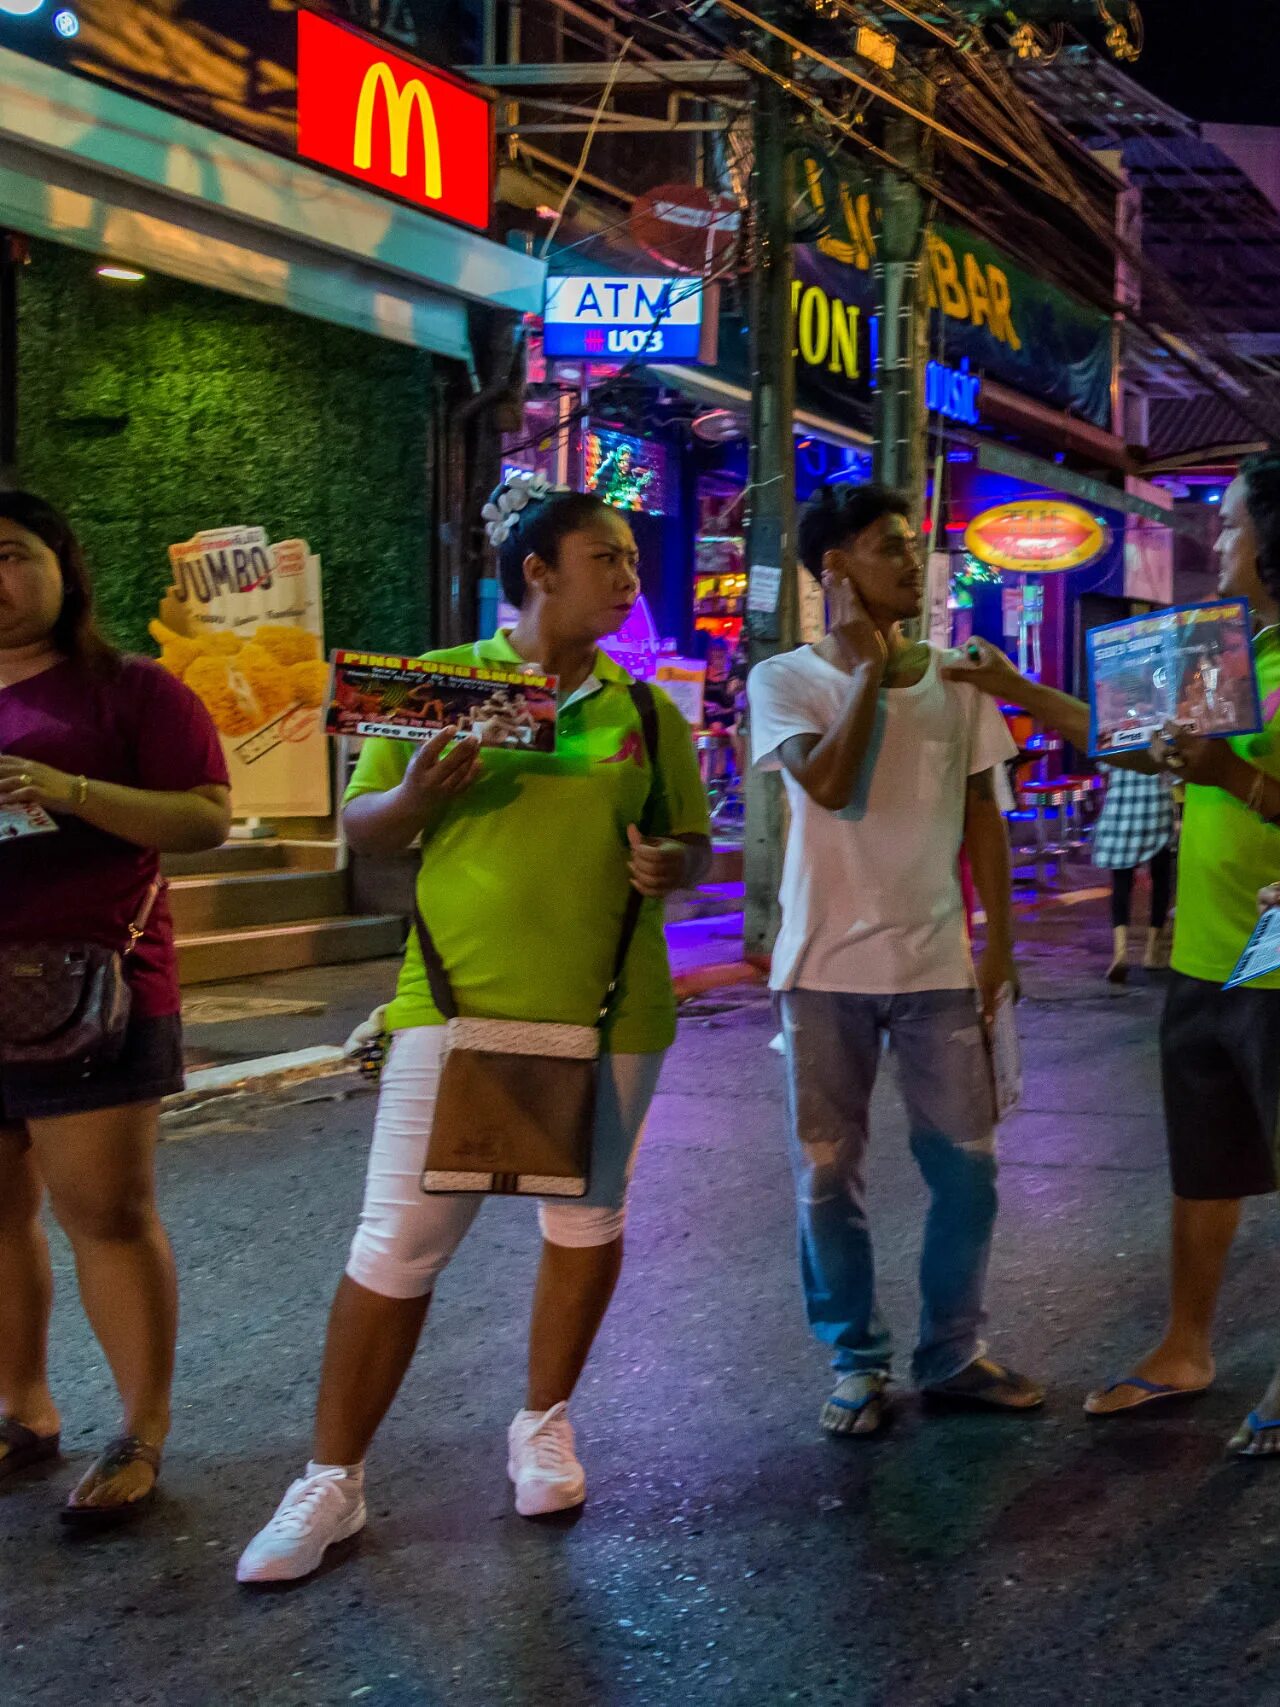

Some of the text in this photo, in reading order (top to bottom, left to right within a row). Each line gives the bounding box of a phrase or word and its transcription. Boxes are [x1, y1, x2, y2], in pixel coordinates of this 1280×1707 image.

[353, 61, 442, 200] M
[575, 283, 672, 318] ATM
[928, 230, 1022, 351] BAR
[791, 279, 861, 379] ON
[174, 546, 273, 604] JUMBO
[343, 652, 401, 669] PING
[406, 659, 471, 678] PONG
[476, 669, 548, 687] SHOW
[362, 724, 401, 737] Free
